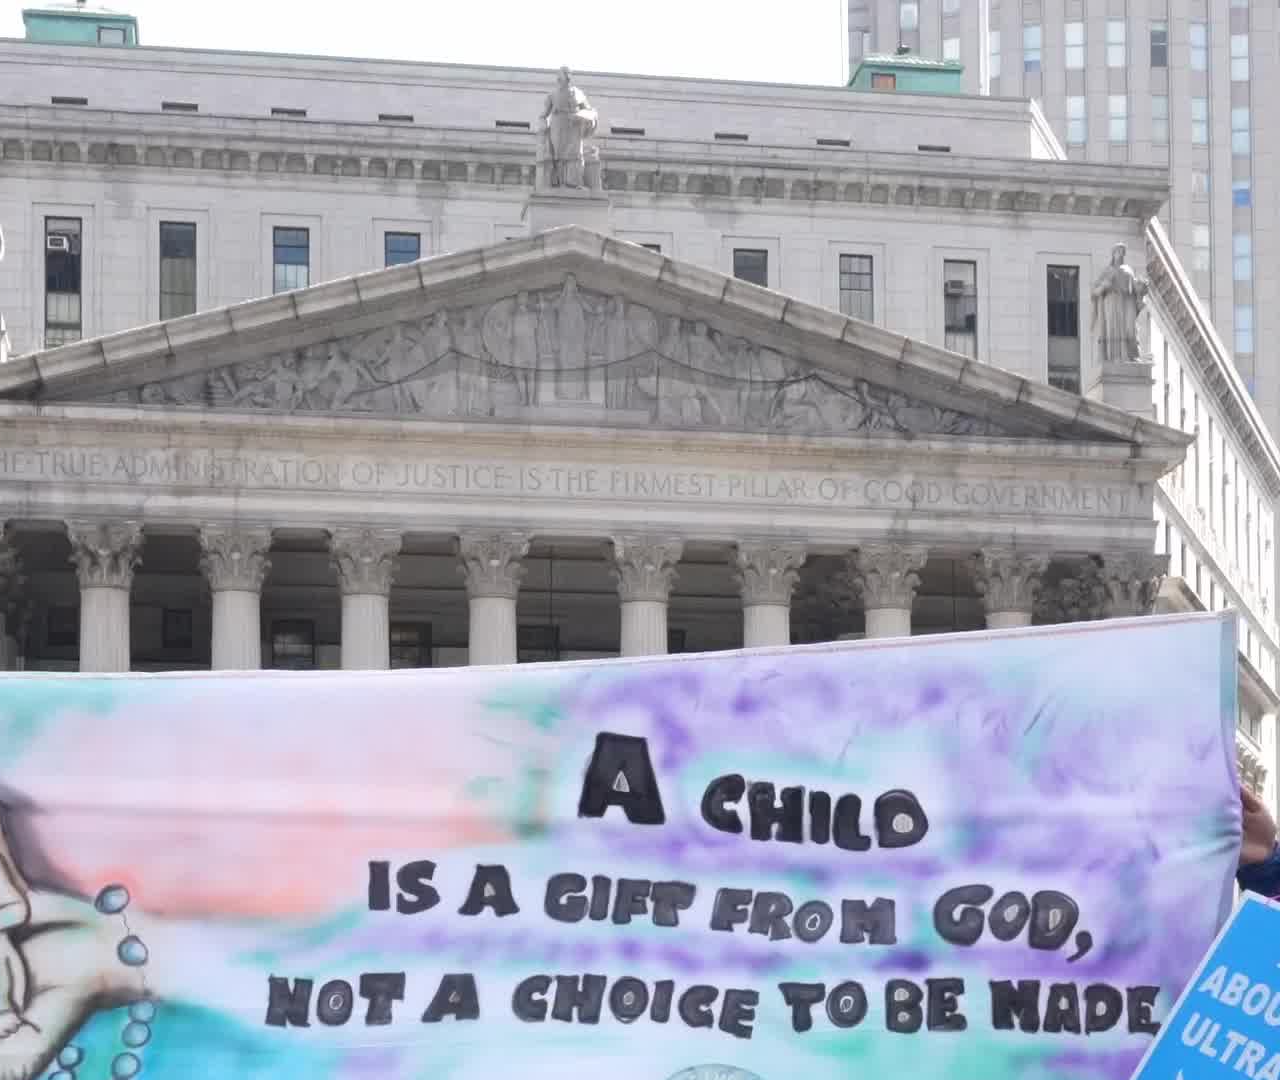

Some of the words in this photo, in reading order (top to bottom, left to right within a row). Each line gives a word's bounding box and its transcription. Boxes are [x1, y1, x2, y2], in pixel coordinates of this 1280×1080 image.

[35, 450, 103, 478] TRUE
[352, 461, 385, 486] OF
[397, 463, 506, 490] JUSTICE
[519, 466, 543, 491] IS
[551, 467, 601, 494] THE
[608, 468, 717, 498] FIRMEST
[728, 473, 808, 500] PILLAR
[819, 477, 858, 501] OF
[863, 478, 942, 504] GOOD
[951, 482, 1131, 513] GOVERNMENT
[578, 731, 666, 825] A
[701, 773, 929, 852] CHILD
[367, 859, 441, 915] IS
[457, 864, 520, 917] A
[543, 872, 697, 928] GIFT
[710, 886, 897, 946] FROM
[933, 883, 1093, 963] GOD,
[264, 971, 406, 1028] NOT
[421, 972, 480, 1023] A
[511, 973, 760, 1039] CHOICE
[778, 980, 868, 1033] TO
[885, 977, 968, 1034] BE
[988, 978, 1162, 1037] MADE
